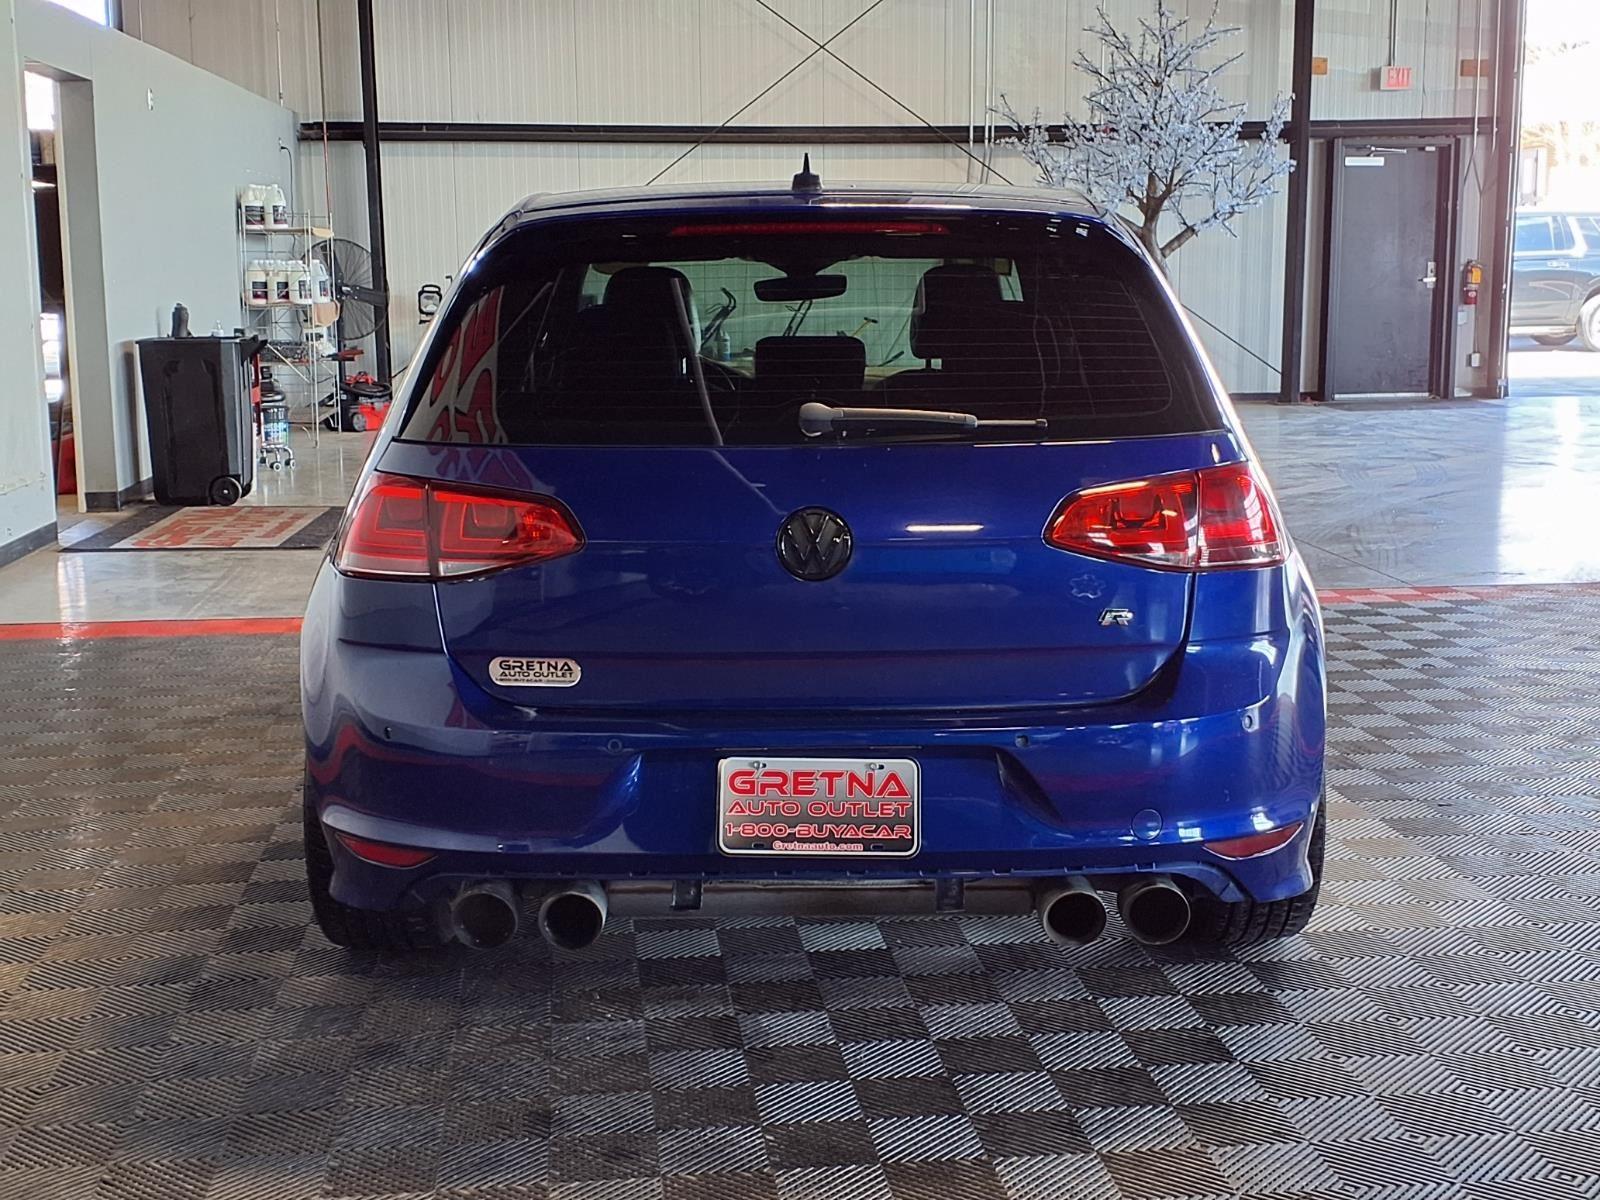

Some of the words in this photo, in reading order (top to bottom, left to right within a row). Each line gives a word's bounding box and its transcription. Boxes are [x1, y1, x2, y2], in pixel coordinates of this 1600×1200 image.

[1387, 67, 1411, 87] EXIT
[499, 660, 573, 671] GRETNA
[728, 769, 911, 798] GRETNA
[726, 800, 801, 817] AUTO
[807, 801, 912, 818] OUTLET
[725, 823, 912, 839] 1-800-BUYACAR
[772, 841, 864, 851] Gretnaauto.com
